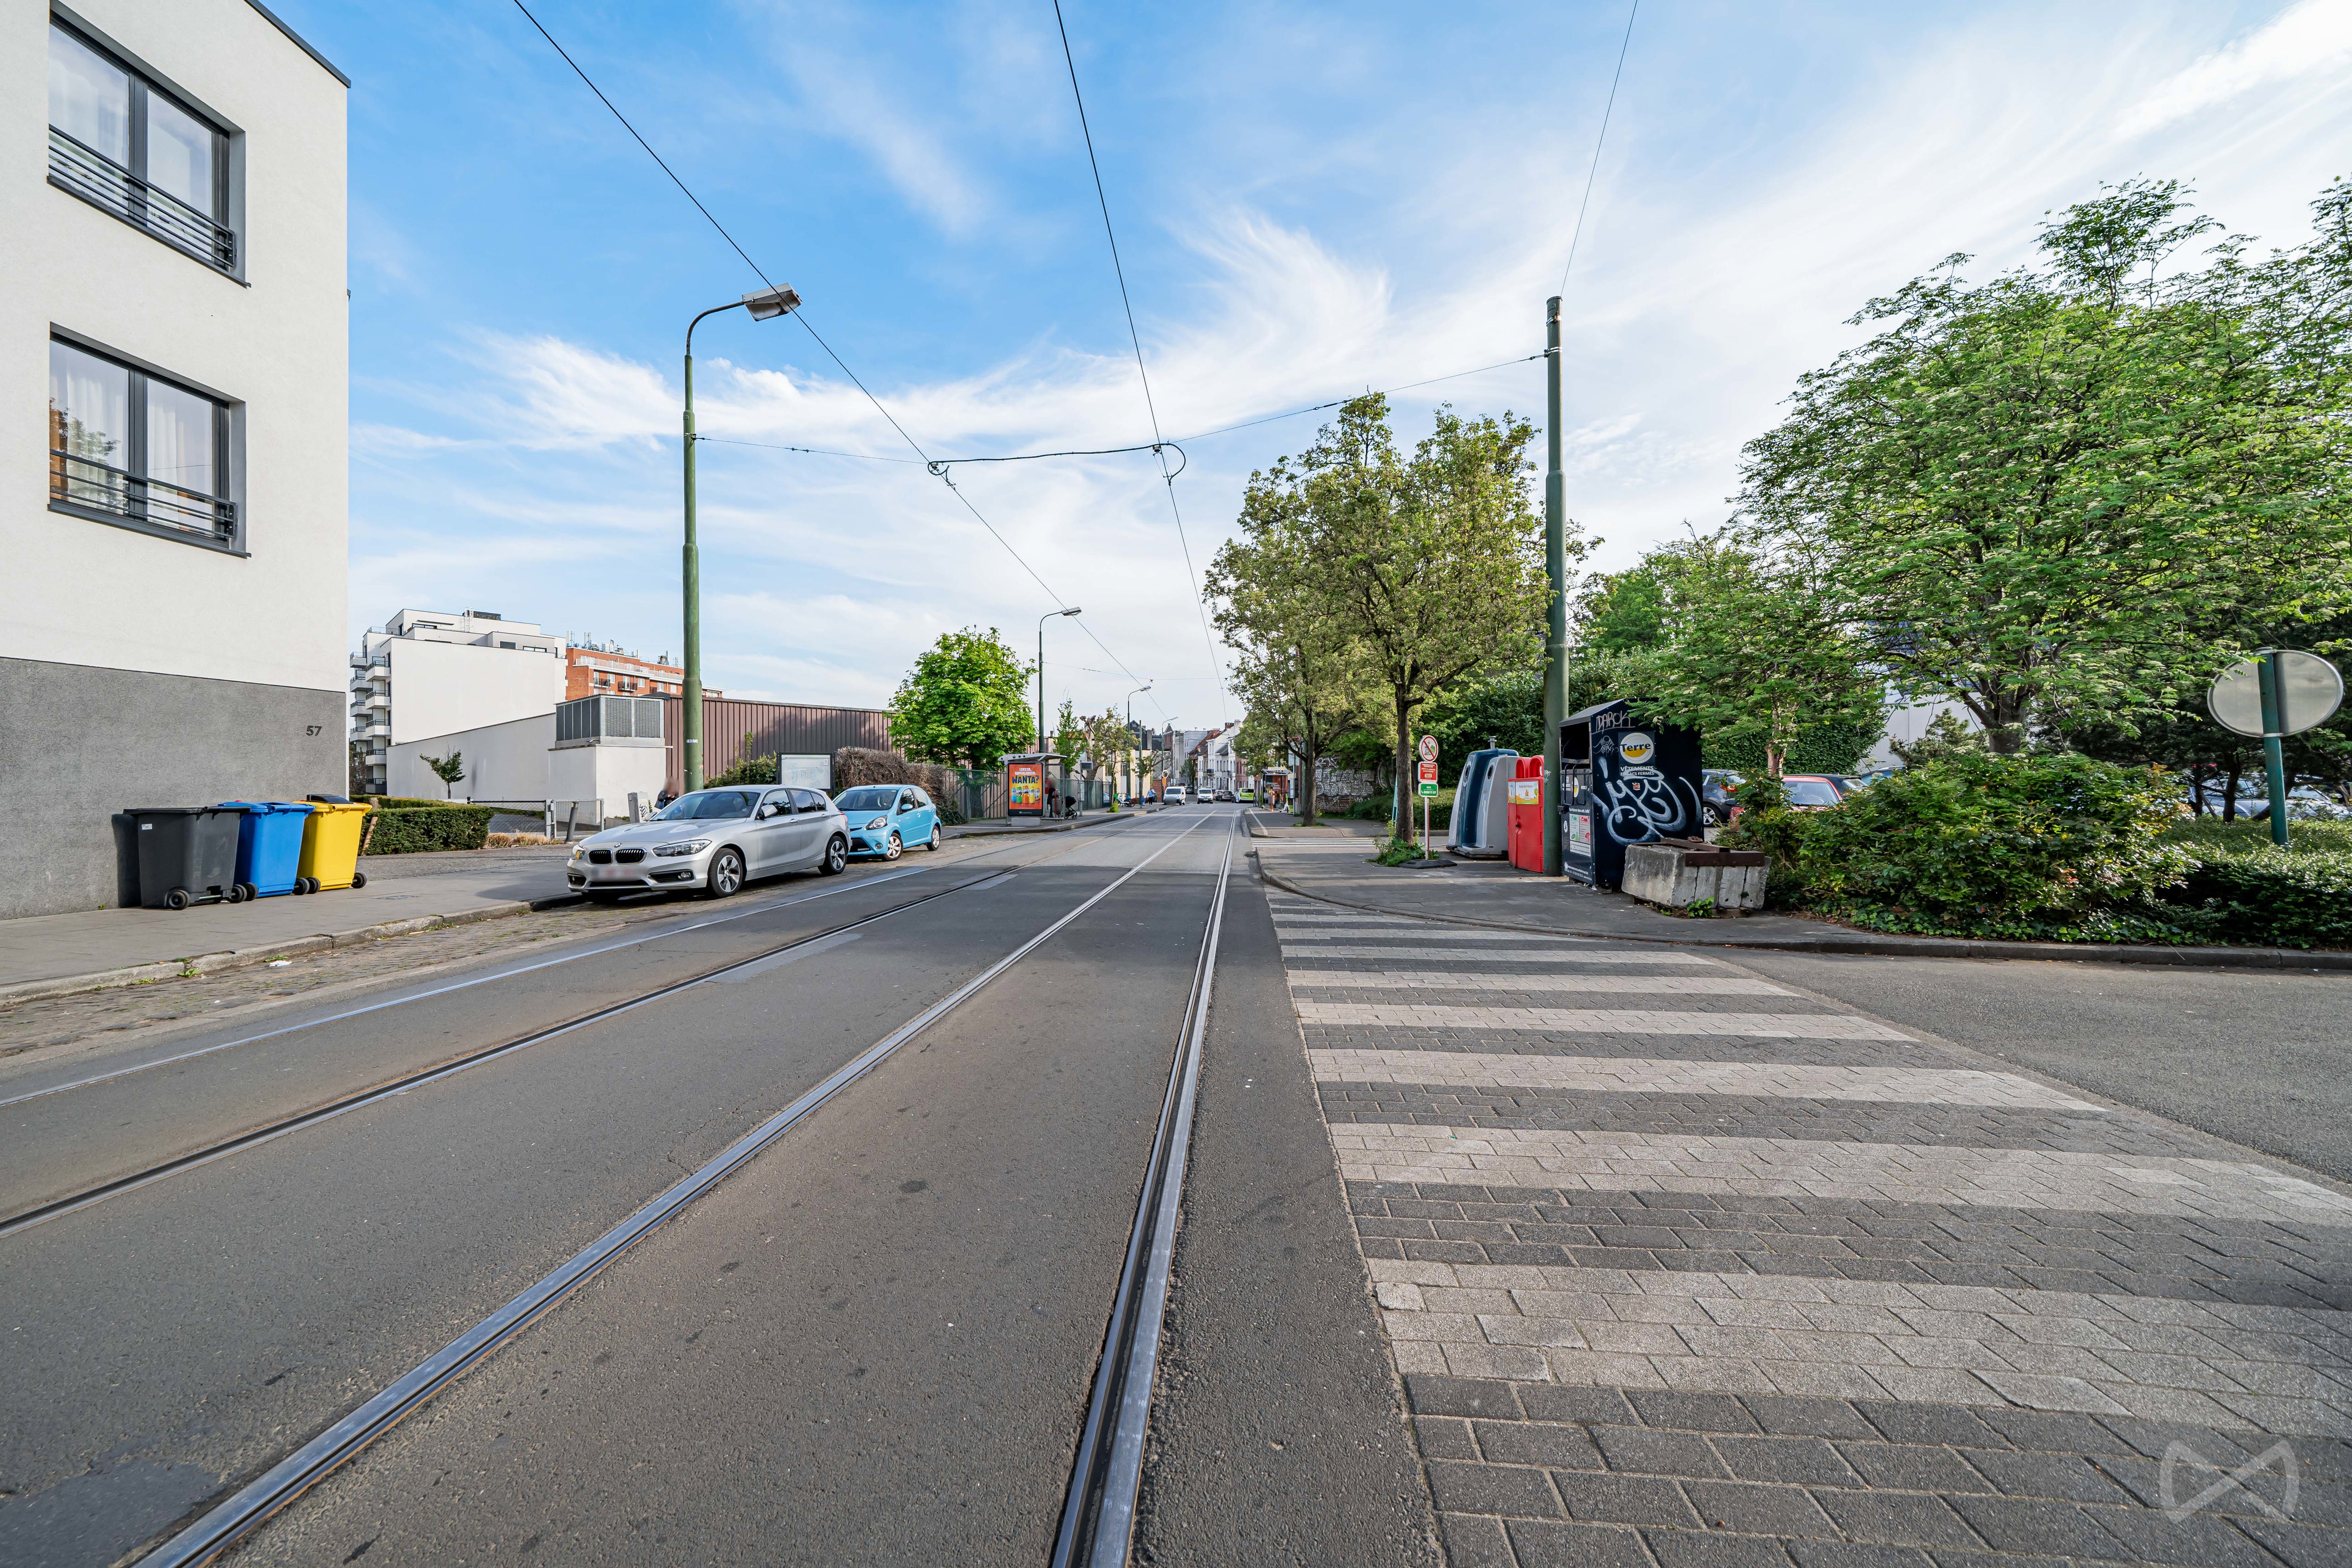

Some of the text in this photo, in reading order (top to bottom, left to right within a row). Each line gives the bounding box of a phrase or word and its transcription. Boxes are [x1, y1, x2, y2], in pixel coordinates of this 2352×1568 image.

[306, 725, 322, 736] 57
[1620, 743, 1651, 752] Terre
[1012, 775, 1039, 784] WANTA?
